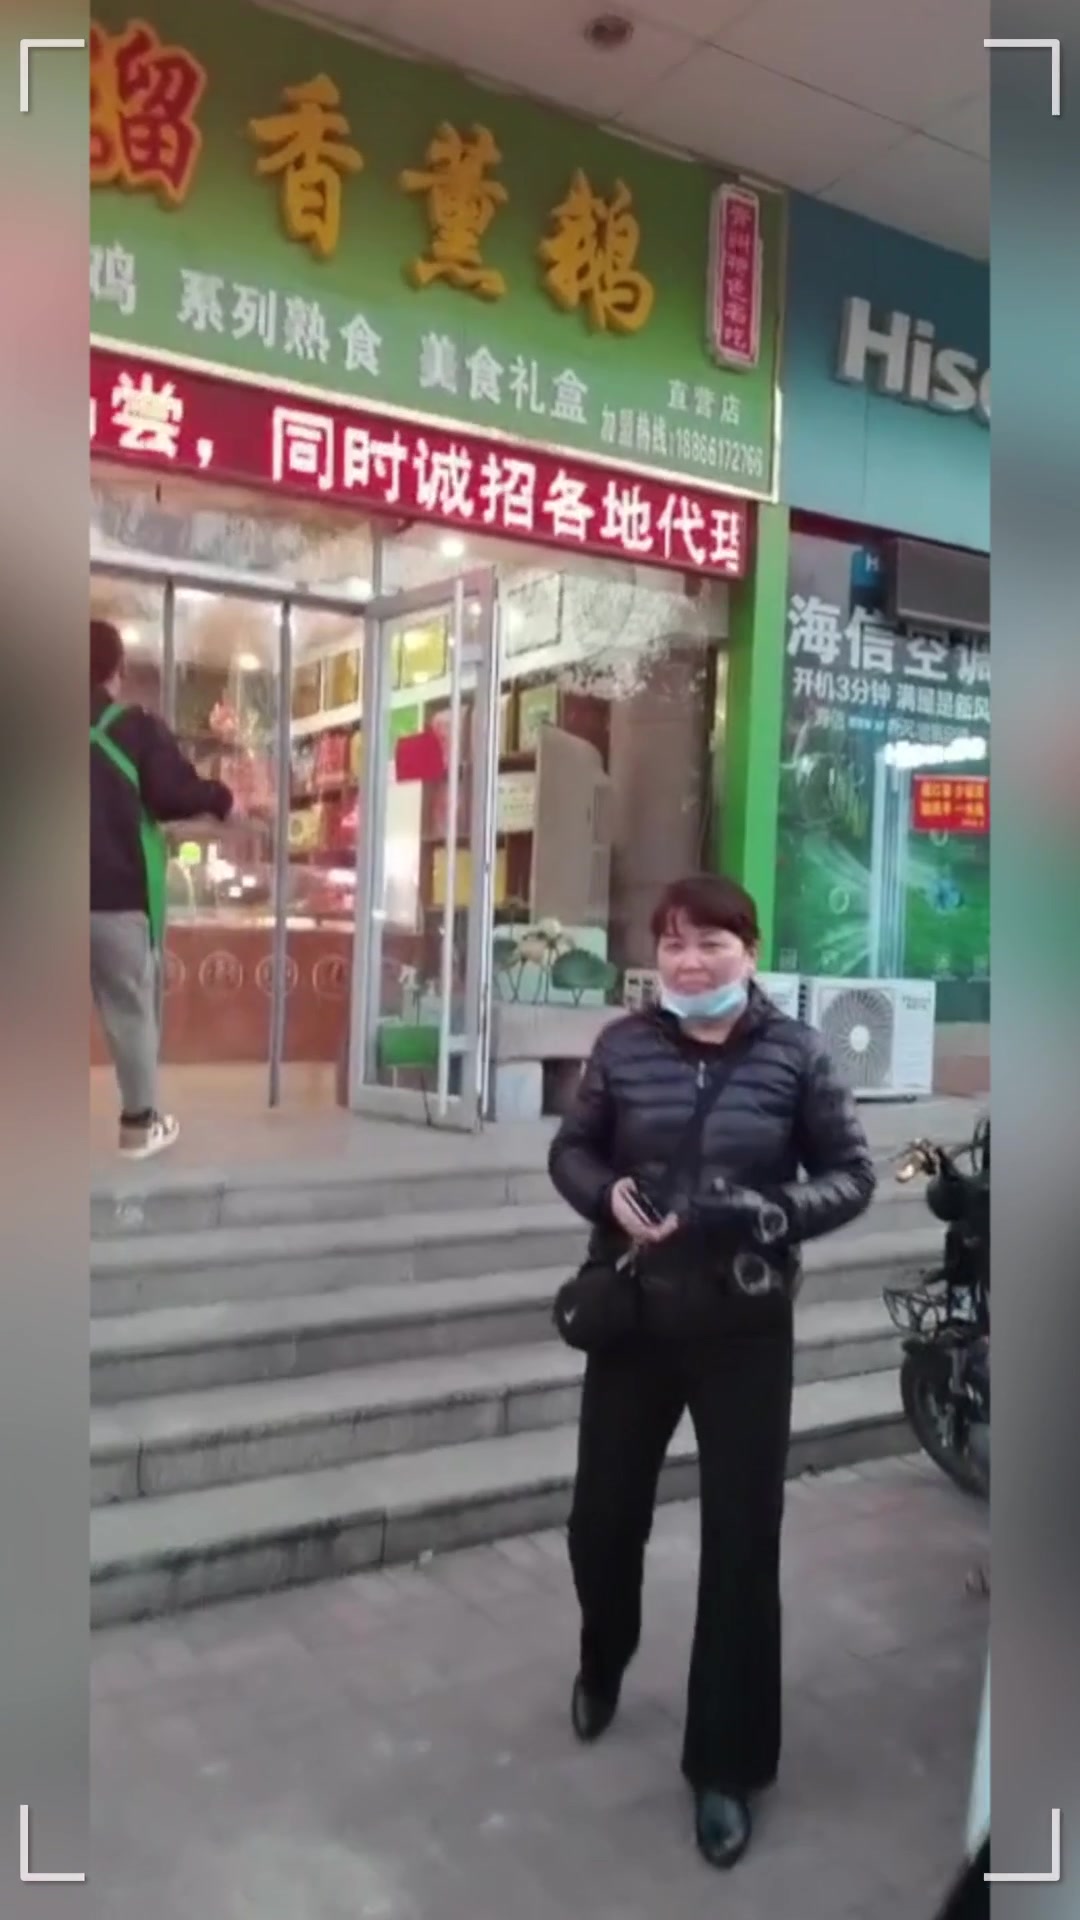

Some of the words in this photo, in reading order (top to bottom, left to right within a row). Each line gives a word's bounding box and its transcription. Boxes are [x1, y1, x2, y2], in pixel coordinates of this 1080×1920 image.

[176, 267, 383, 377] 系列熟食
[418, 331, 588, 424] 美食礼盒
[840, 296, 990, 422] His
[666, 379, 741, 426] 直营店
[793, 666, 892, 709] 开机3分钟
